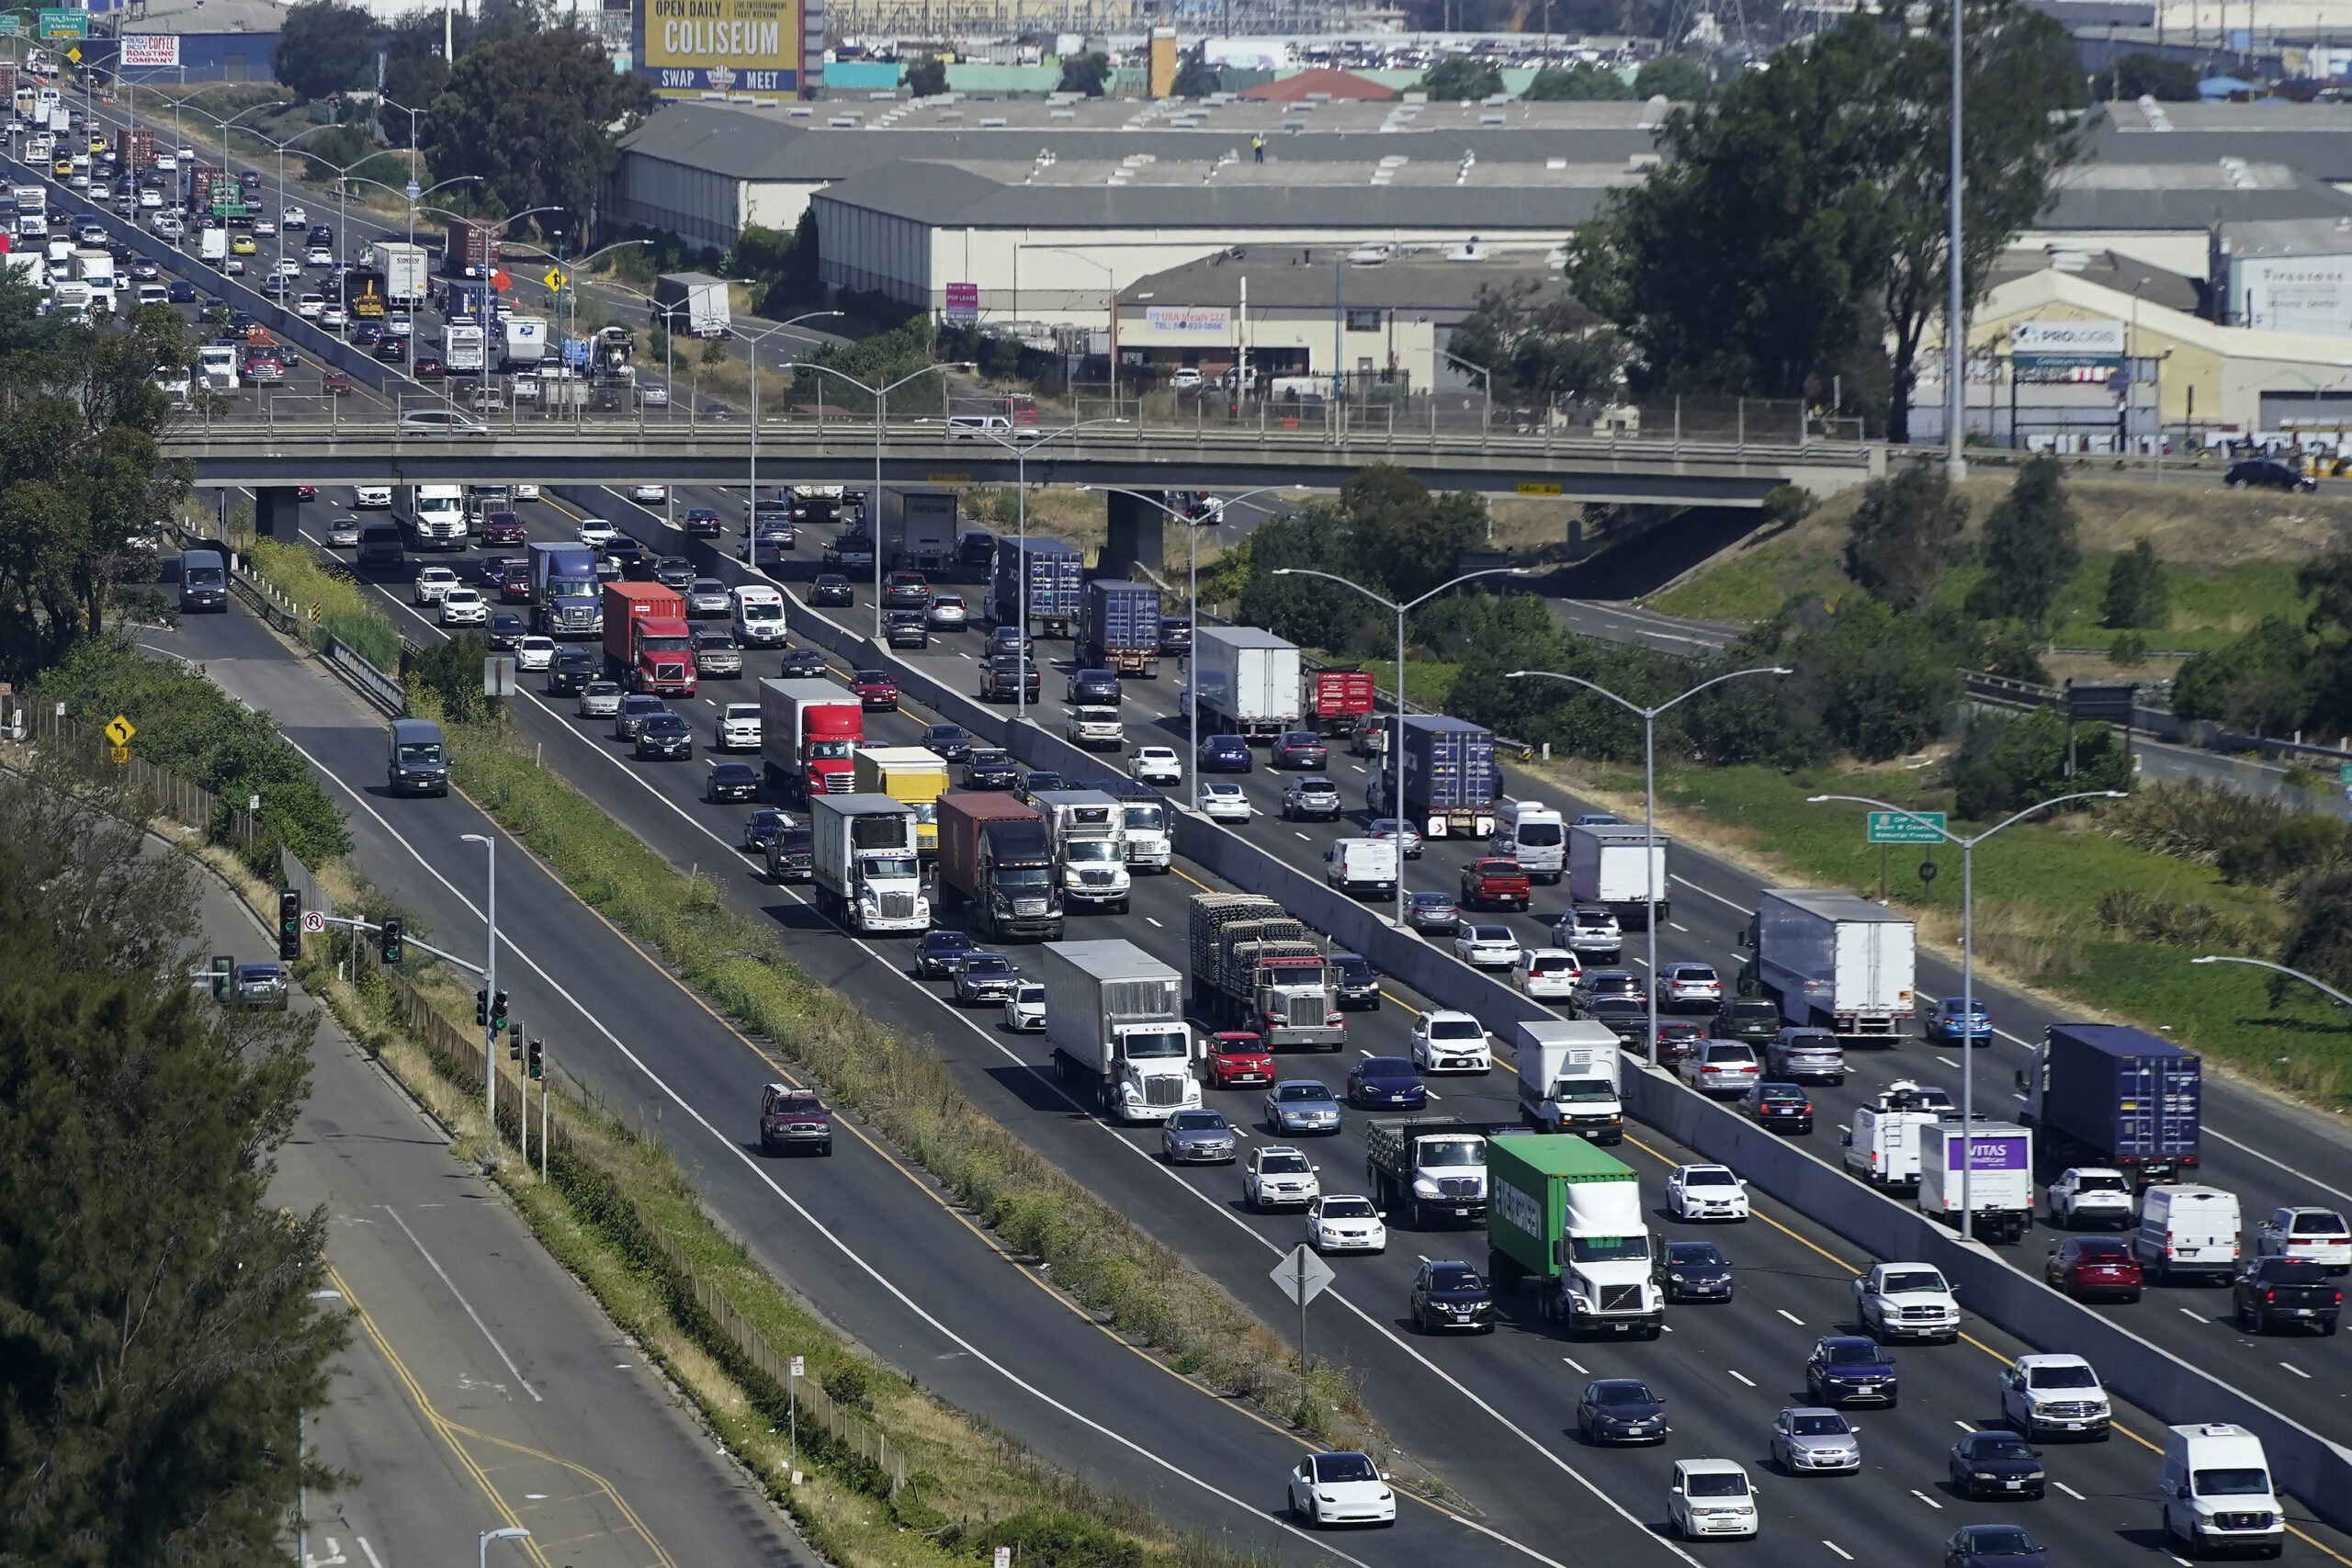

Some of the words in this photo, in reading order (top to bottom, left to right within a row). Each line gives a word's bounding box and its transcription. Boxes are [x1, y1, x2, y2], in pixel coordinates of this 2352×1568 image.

[656, 0, 684, 17] OPEN
[690, 0, 721, 17] DAILY
[148, 36, 175, 50] COFFEE
[664, 19, 779, 55] COLISEUM
[662, 69, 695, 87] SWAP
[746, 71, 779, 89] MEET
[1211, 313, 1227, 321] LLC
[1969, 1145, 2007, 1156] VITAS
[1494, 1175, 1542, 1241] EVERGREEN
